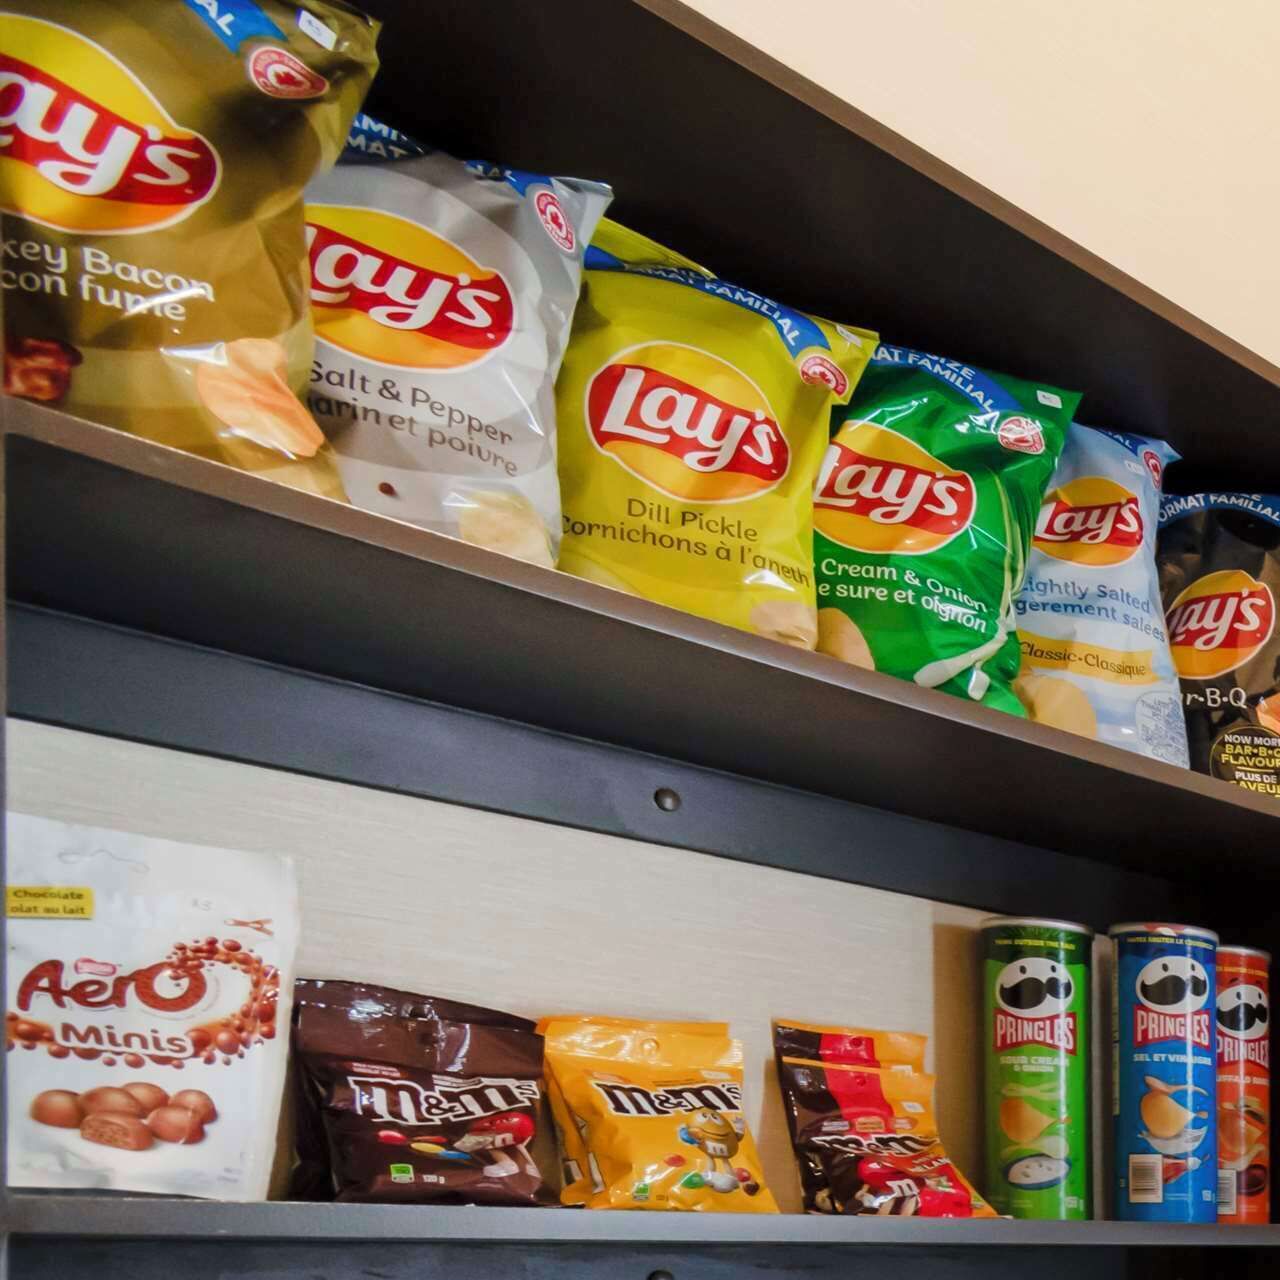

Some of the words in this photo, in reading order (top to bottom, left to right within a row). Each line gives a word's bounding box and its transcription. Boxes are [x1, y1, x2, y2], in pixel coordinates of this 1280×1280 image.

[0, 73, 200, 196] ay's
[81, 247, 215, 304] Bacon
[704, 279, 805, 348] FAMILIAL
[310, 360, 373, 394] Salt
[377, 377, 403, 403] &
[411, 387, 514, 446] Pepper
[907, 352, 995, 413] FAMILIAL
[600, 367, 778, 473] Lay's
[388, 412, 418, 439] et
[427, 426, 518, 477] poivre
[814, 445, 966, 525] Lay's
[1158, 493, 1205, 522] ORMAT
[1209, 493, 1280, 522] FAMILIAL
[626, 497, 670, 526] Dill
[680, 511, 759, 543] Pickle
[1034, 498, 1140, 545] Lay's
[560, 514, 708, 558] Cornichons
[715, 540, 732, 562] à
[739, 541, 811, 589] l'aneth
[821, 558, 897, 582] Cream
[903, 569, 923, 588] &
[926, 578, 988, 614] Onion
[836, 582, 888, 601] sure
[893, 586, 916, 603] et
[1096, 583, 1151, 615] Salted
[1224, 733, 1253, 746] NOW
[1235, 771, 1262, 783] PLUS
[1262, 772, 1278, 784] DE
[43, 905, 60, 916] au
[61, 904, 86, 916] lait
[59, 1021, 189, 1055] Minis
[995, 1014, 1075, 1050] PRINGLES
[1136, 1010, 1211, 1048] PRINGLES
